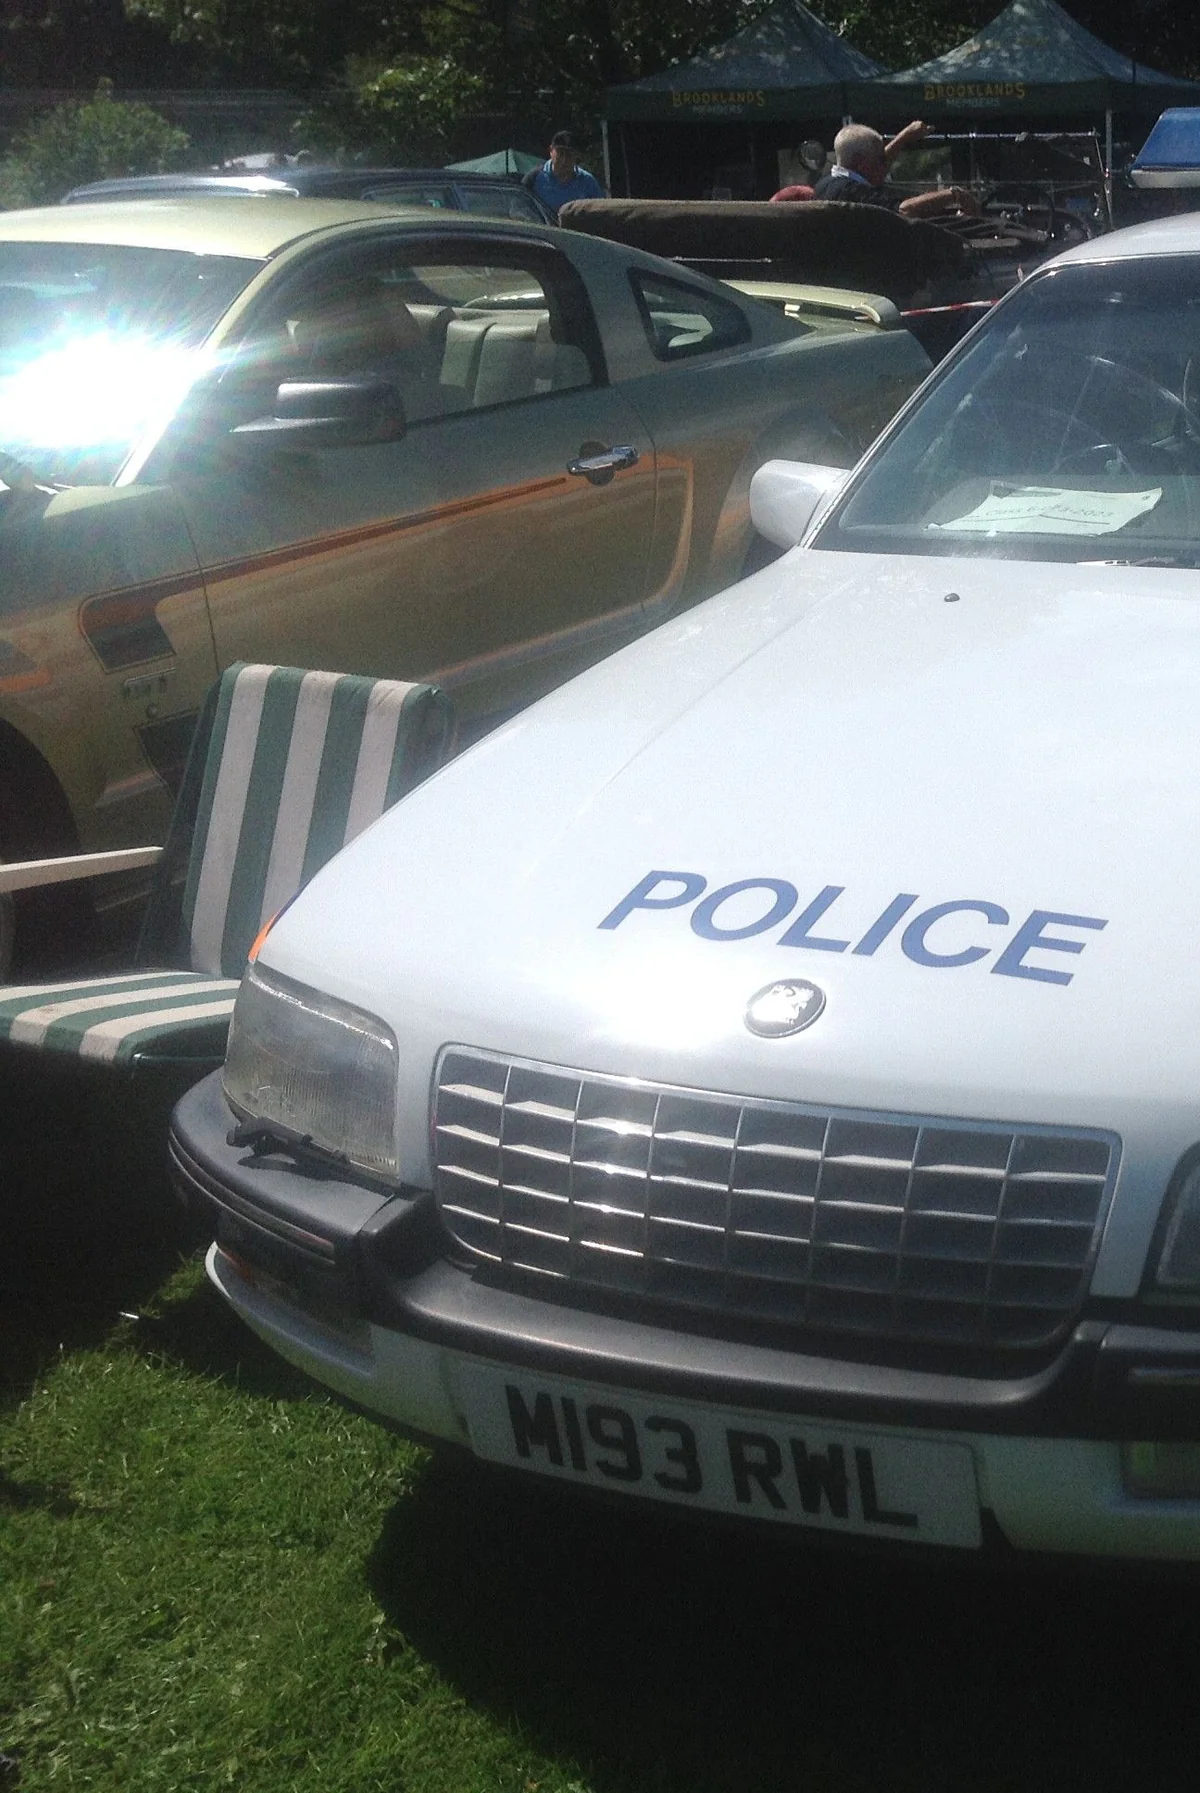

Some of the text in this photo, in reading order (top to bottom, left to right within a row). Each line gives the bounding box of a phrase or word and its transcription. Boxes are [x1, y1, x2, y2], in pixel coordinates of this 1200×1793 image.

[672, 89, 765, 108] BROOKLANDS
[924, 82, 1026, 101] BROOKLANDS
[596, 869, 1110, 987] POLICE
[504, 1384, 919, 1529] M193 RWL
